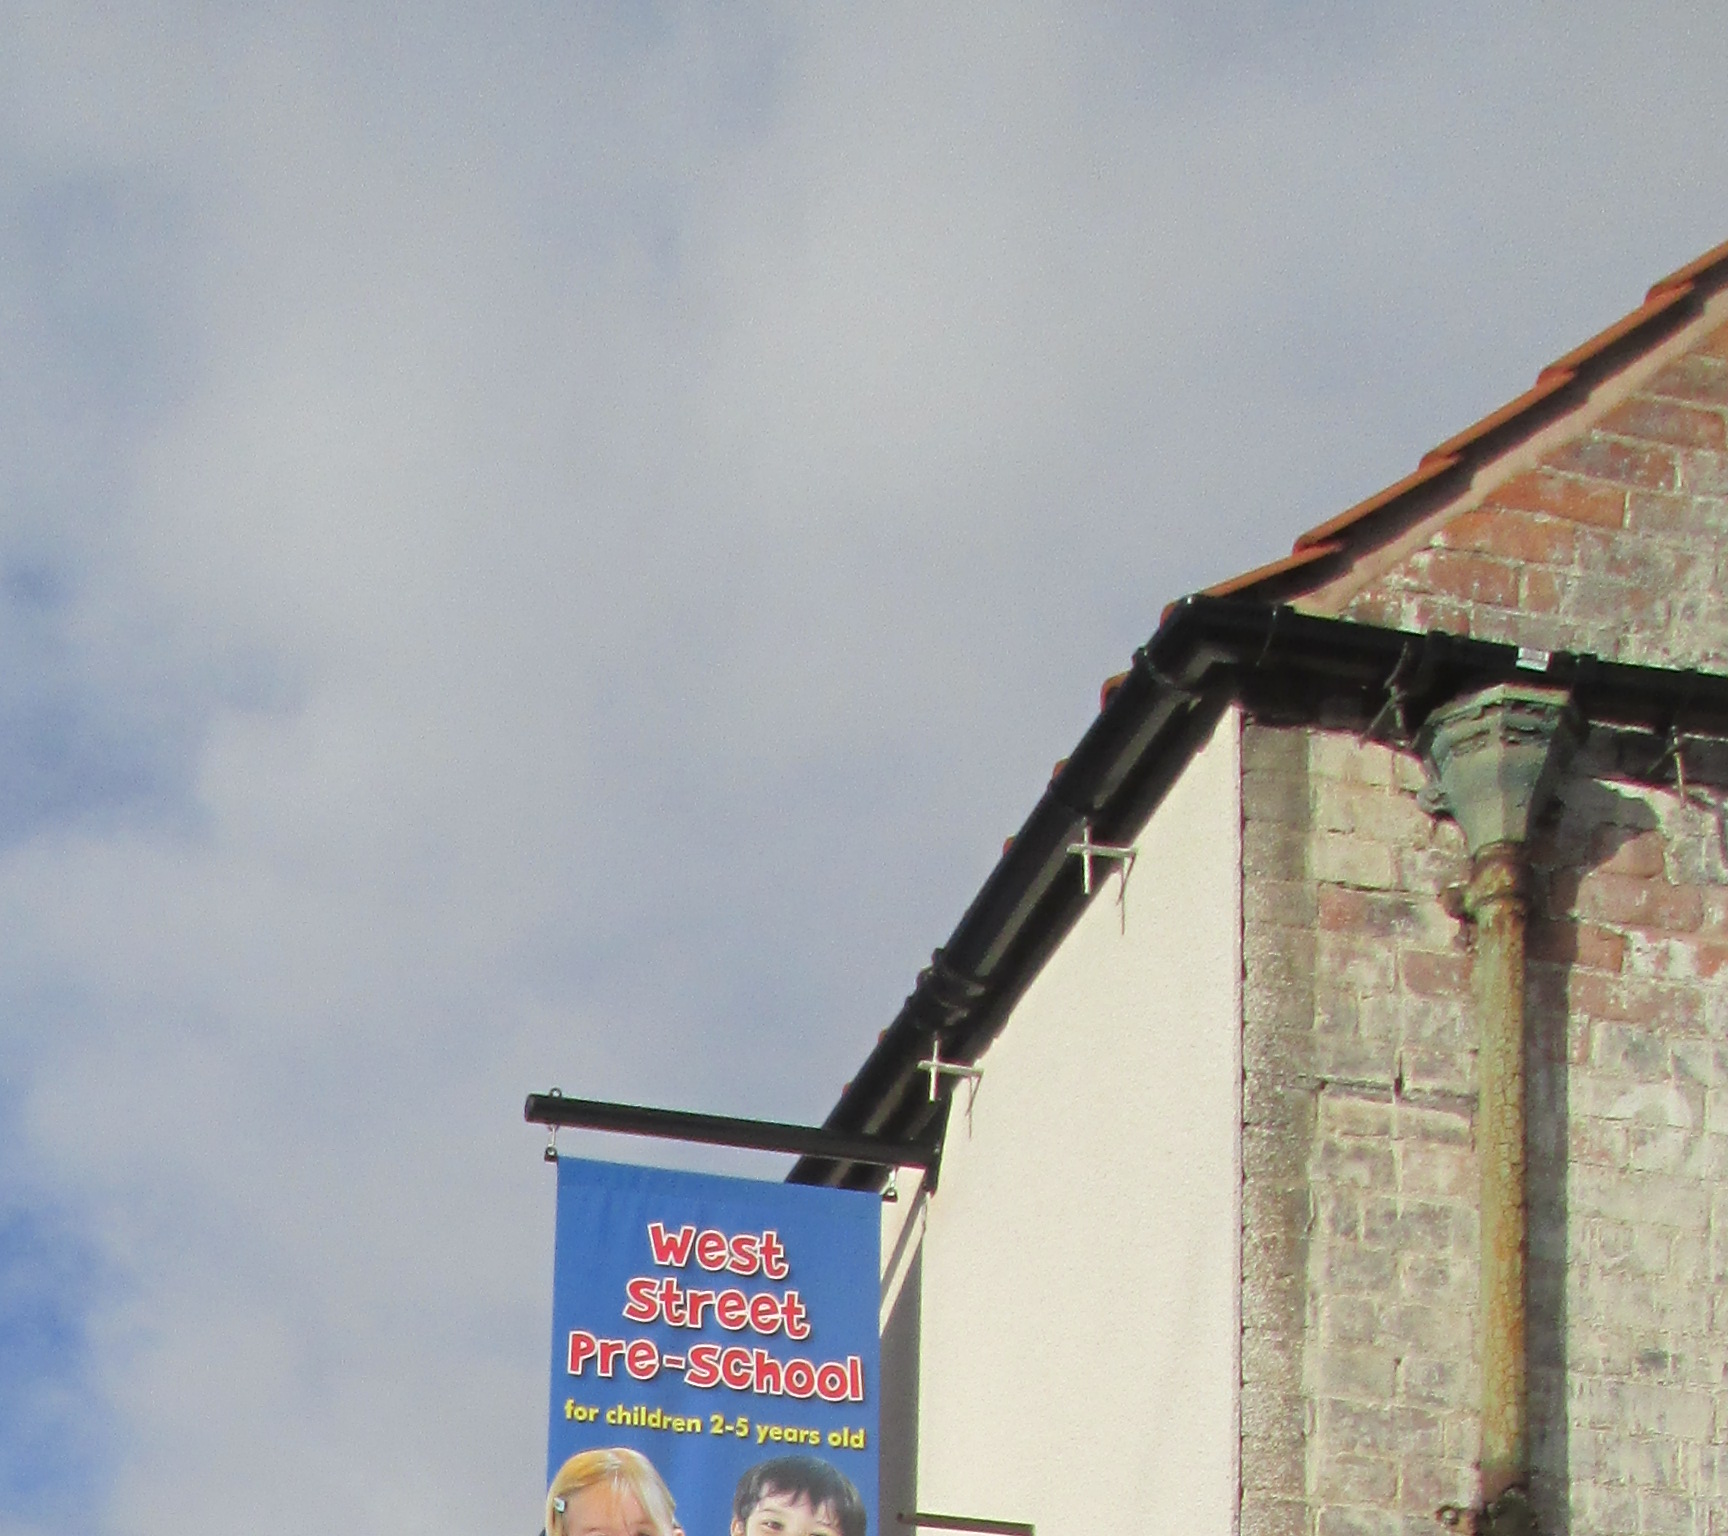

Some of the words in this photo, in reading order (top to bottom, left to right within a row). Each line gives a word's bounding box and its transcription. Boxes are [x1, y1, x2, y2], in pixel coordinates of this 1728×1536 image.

[647, 1222, 789, 1280] West
[622, 1277, 811, 1340] Street
[565, 1400, 599, 1424] for
[605, 1406, 701, 1435] children
[709, 1417, 748, 1438] 2-5
[756, 1424, 821, 1448] years
[827, 1427, 865, 1449] old
